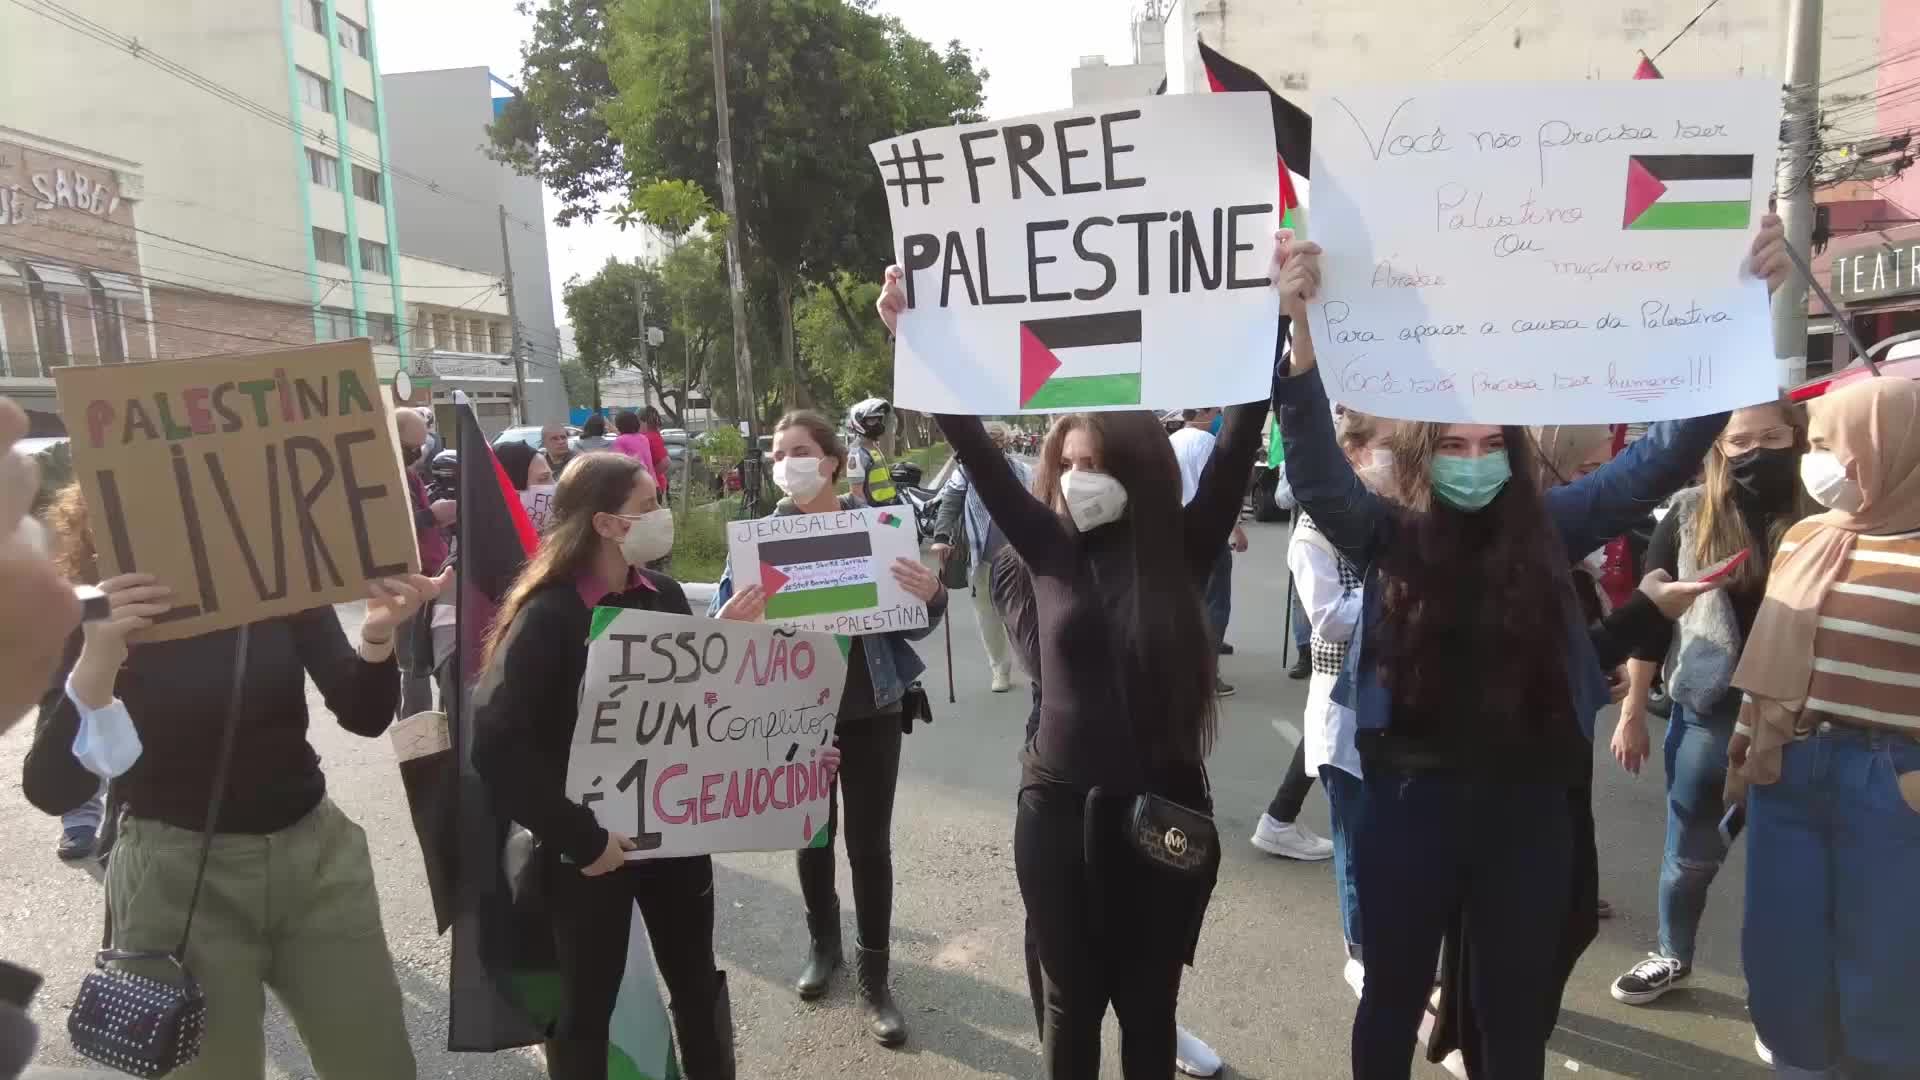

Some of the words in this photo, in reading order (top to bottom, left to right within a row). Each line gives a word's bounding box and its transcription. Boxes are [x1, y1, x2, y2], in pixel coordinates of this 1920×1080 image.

[1331, 97, 1452, 160] Você
[1322, 300, 1385, 345] Para
[1597, 312, 1630, 331] da
[737, 510, 868, 543] JERUSALEM
[608, 631, 729, 684] ISSO
[734, 628, 816, 686] NÃO
[590, 685, 629, 744] É
[636, 700, 699, 748] UM
